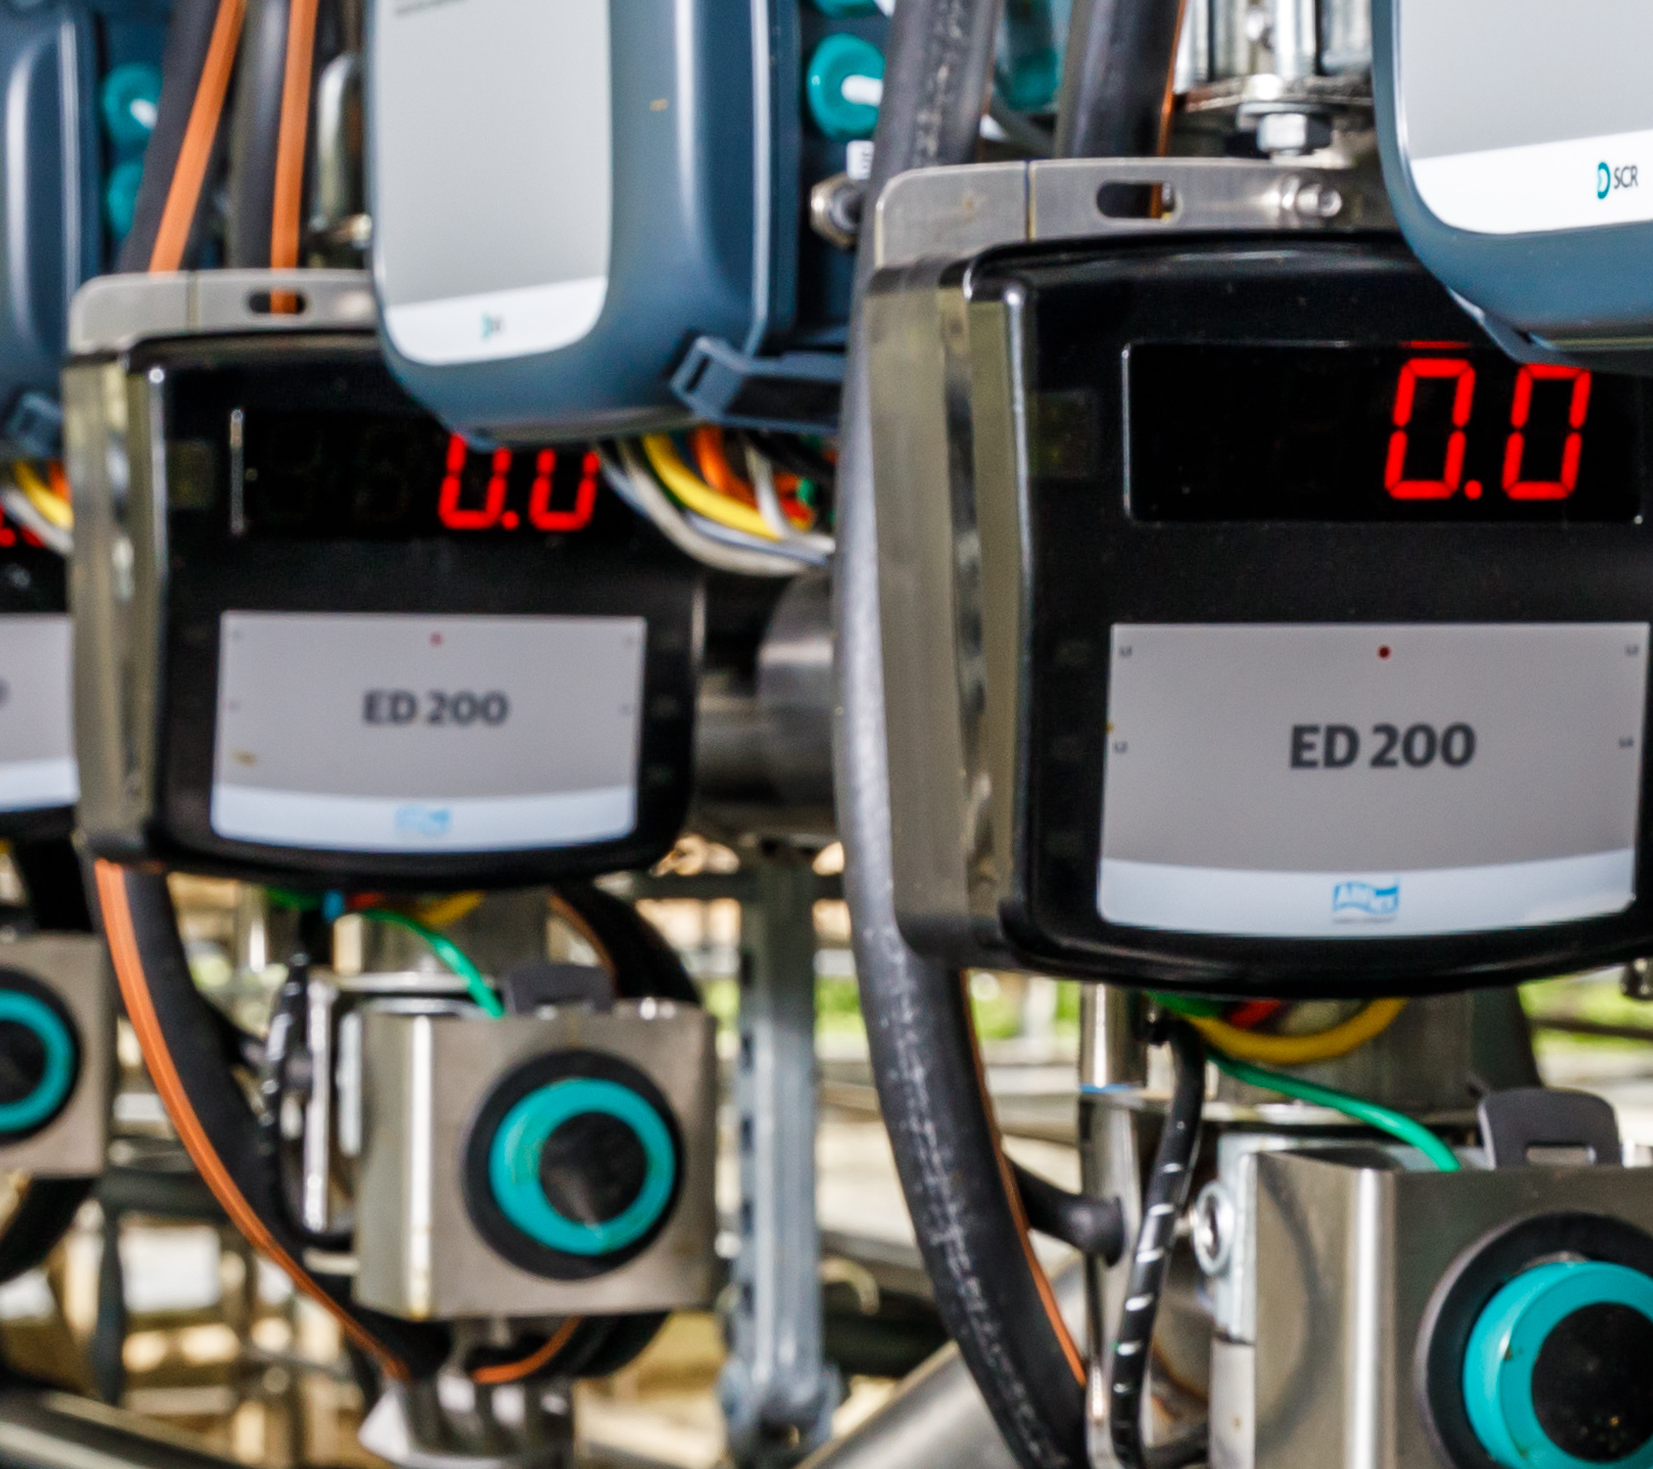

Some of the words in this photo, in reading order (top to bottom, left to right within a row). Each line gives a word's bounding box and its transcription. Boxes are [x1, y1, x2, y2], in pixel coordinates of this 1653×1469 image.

[1614, 164, 1638, 189] SCR
[1384, 357, 1592, 499] 0.0
[362, 689, 417, 725] ED
[425, 689, 509, 726] 200
[1290, 725, 1360, 769] ED
[1369, 723, 1476, 768] 200
